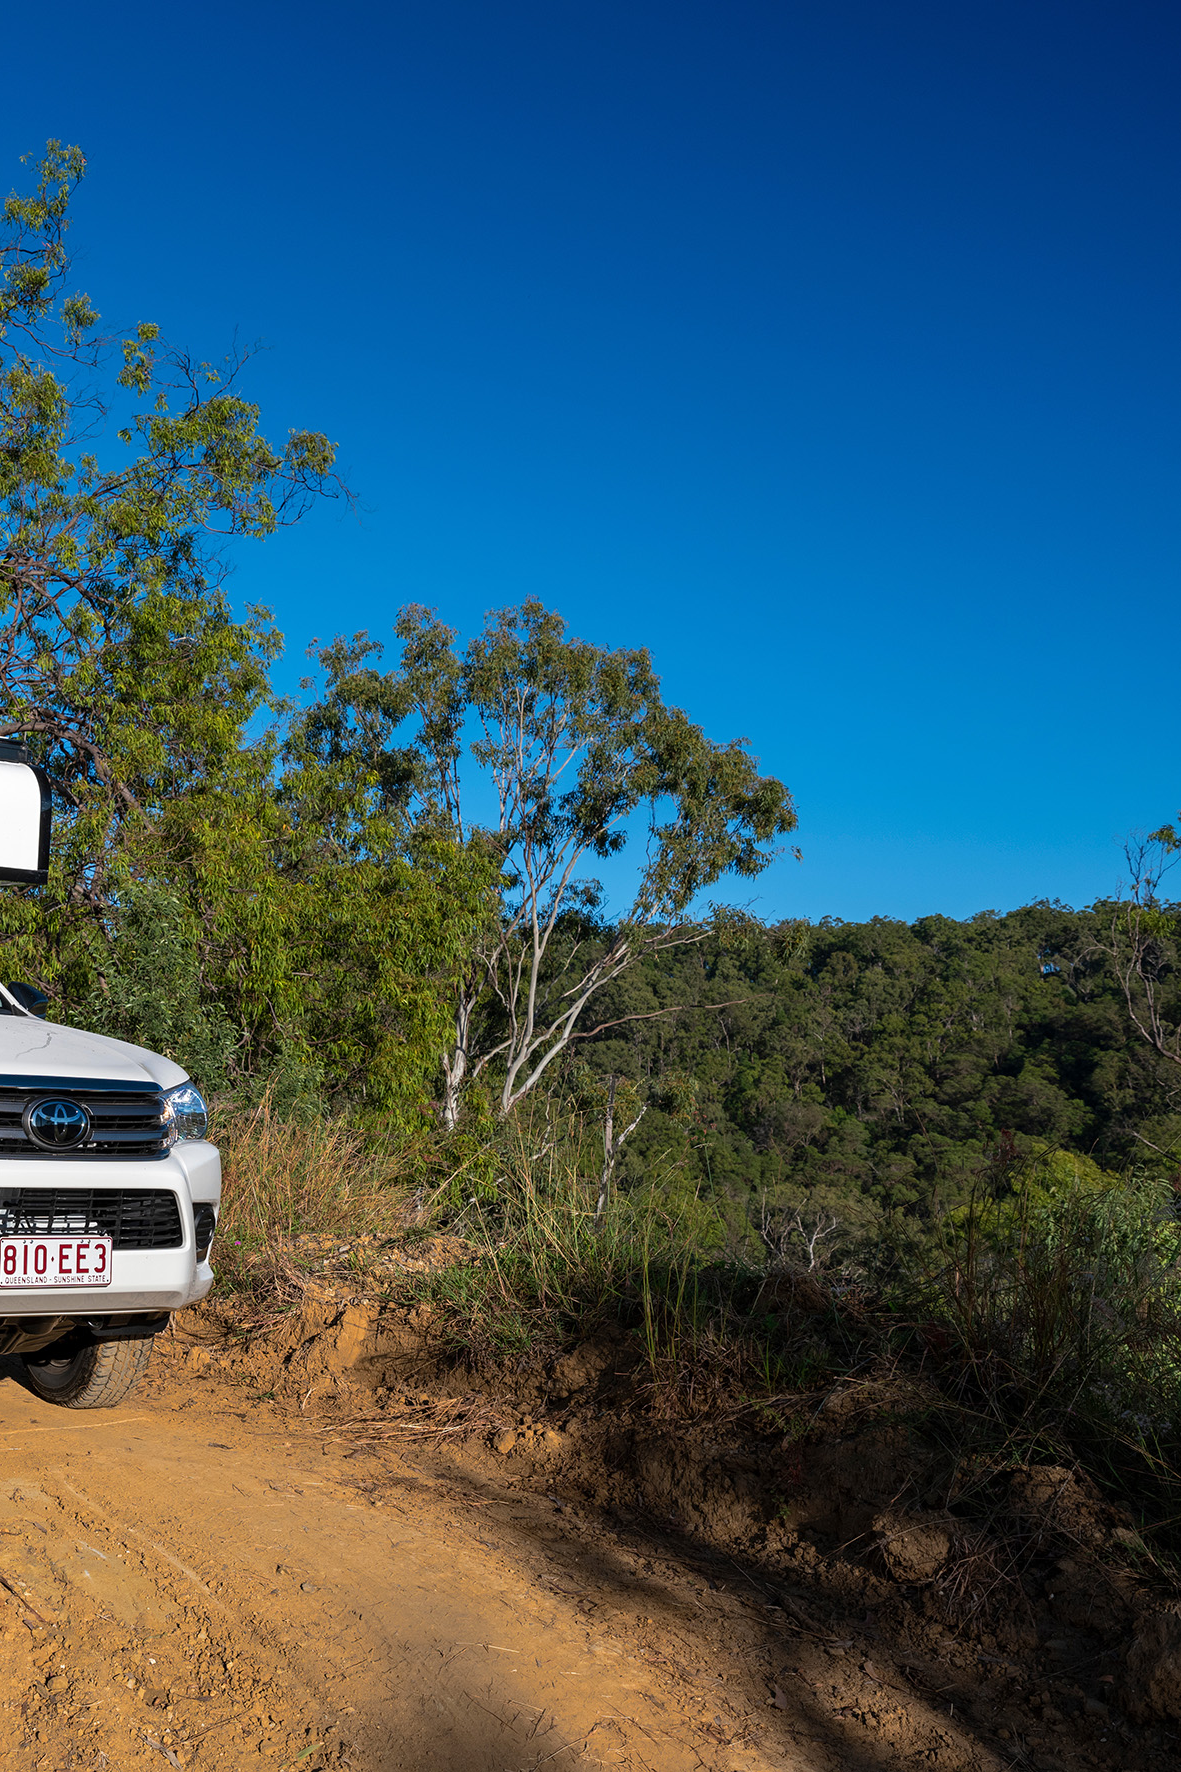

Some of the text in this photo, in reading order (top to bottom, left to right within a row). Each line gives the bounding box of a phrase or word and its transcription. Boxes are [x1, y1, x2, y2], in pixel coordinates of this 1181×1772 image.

[5, 1276, 48, 1285] QUEENSLAND
[53, 1275, 85, 1283] SUNSHINE
[88, 1275, 106, 1283] STATE
